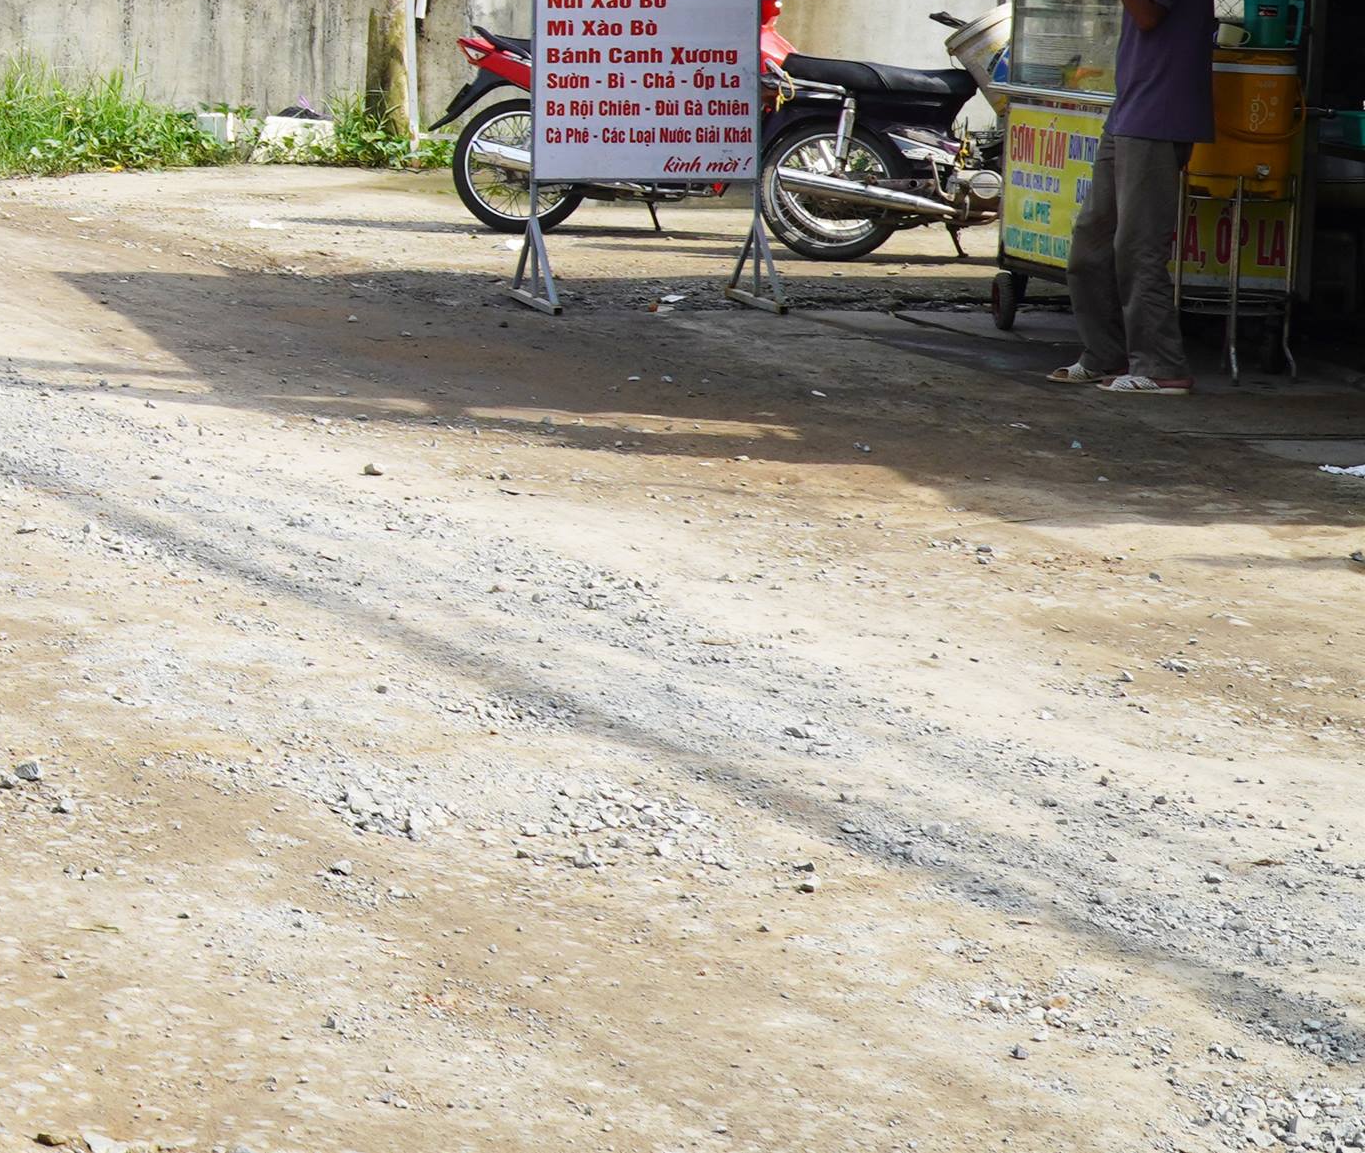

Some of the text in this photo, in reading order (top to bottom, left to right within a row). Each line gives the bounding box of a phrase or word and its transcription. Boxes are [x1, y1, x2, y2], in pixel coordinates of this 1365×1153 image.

[547, 19, 658, 36] Mì Xào Bò
[546, 47, 738, 65] Bánh Canh Xương
[546, 72, 590, 89] Sườn
[607, 72, 624, 89] Bì
[643, 70, 675, 89] Chả
[693, 67, 715, 90] Ốp
[720, 73, 740, 89] La
[546, 100, 565, 116] Ba
[570, 100, 594, 120] Rội
[598, 100, 640, 116] Chiên
[655, 99, 679, 116] Đùi
[684, 99, 703, 116] Gà
[708, 100, 749, 116] Chiên
[546, 125, 752, 147] Cà Phê Các Loại Nước Giải Khát
[1010, 117, 1068, 169] CƠM TẤM
[1256, 219, 1287, 267] LA
